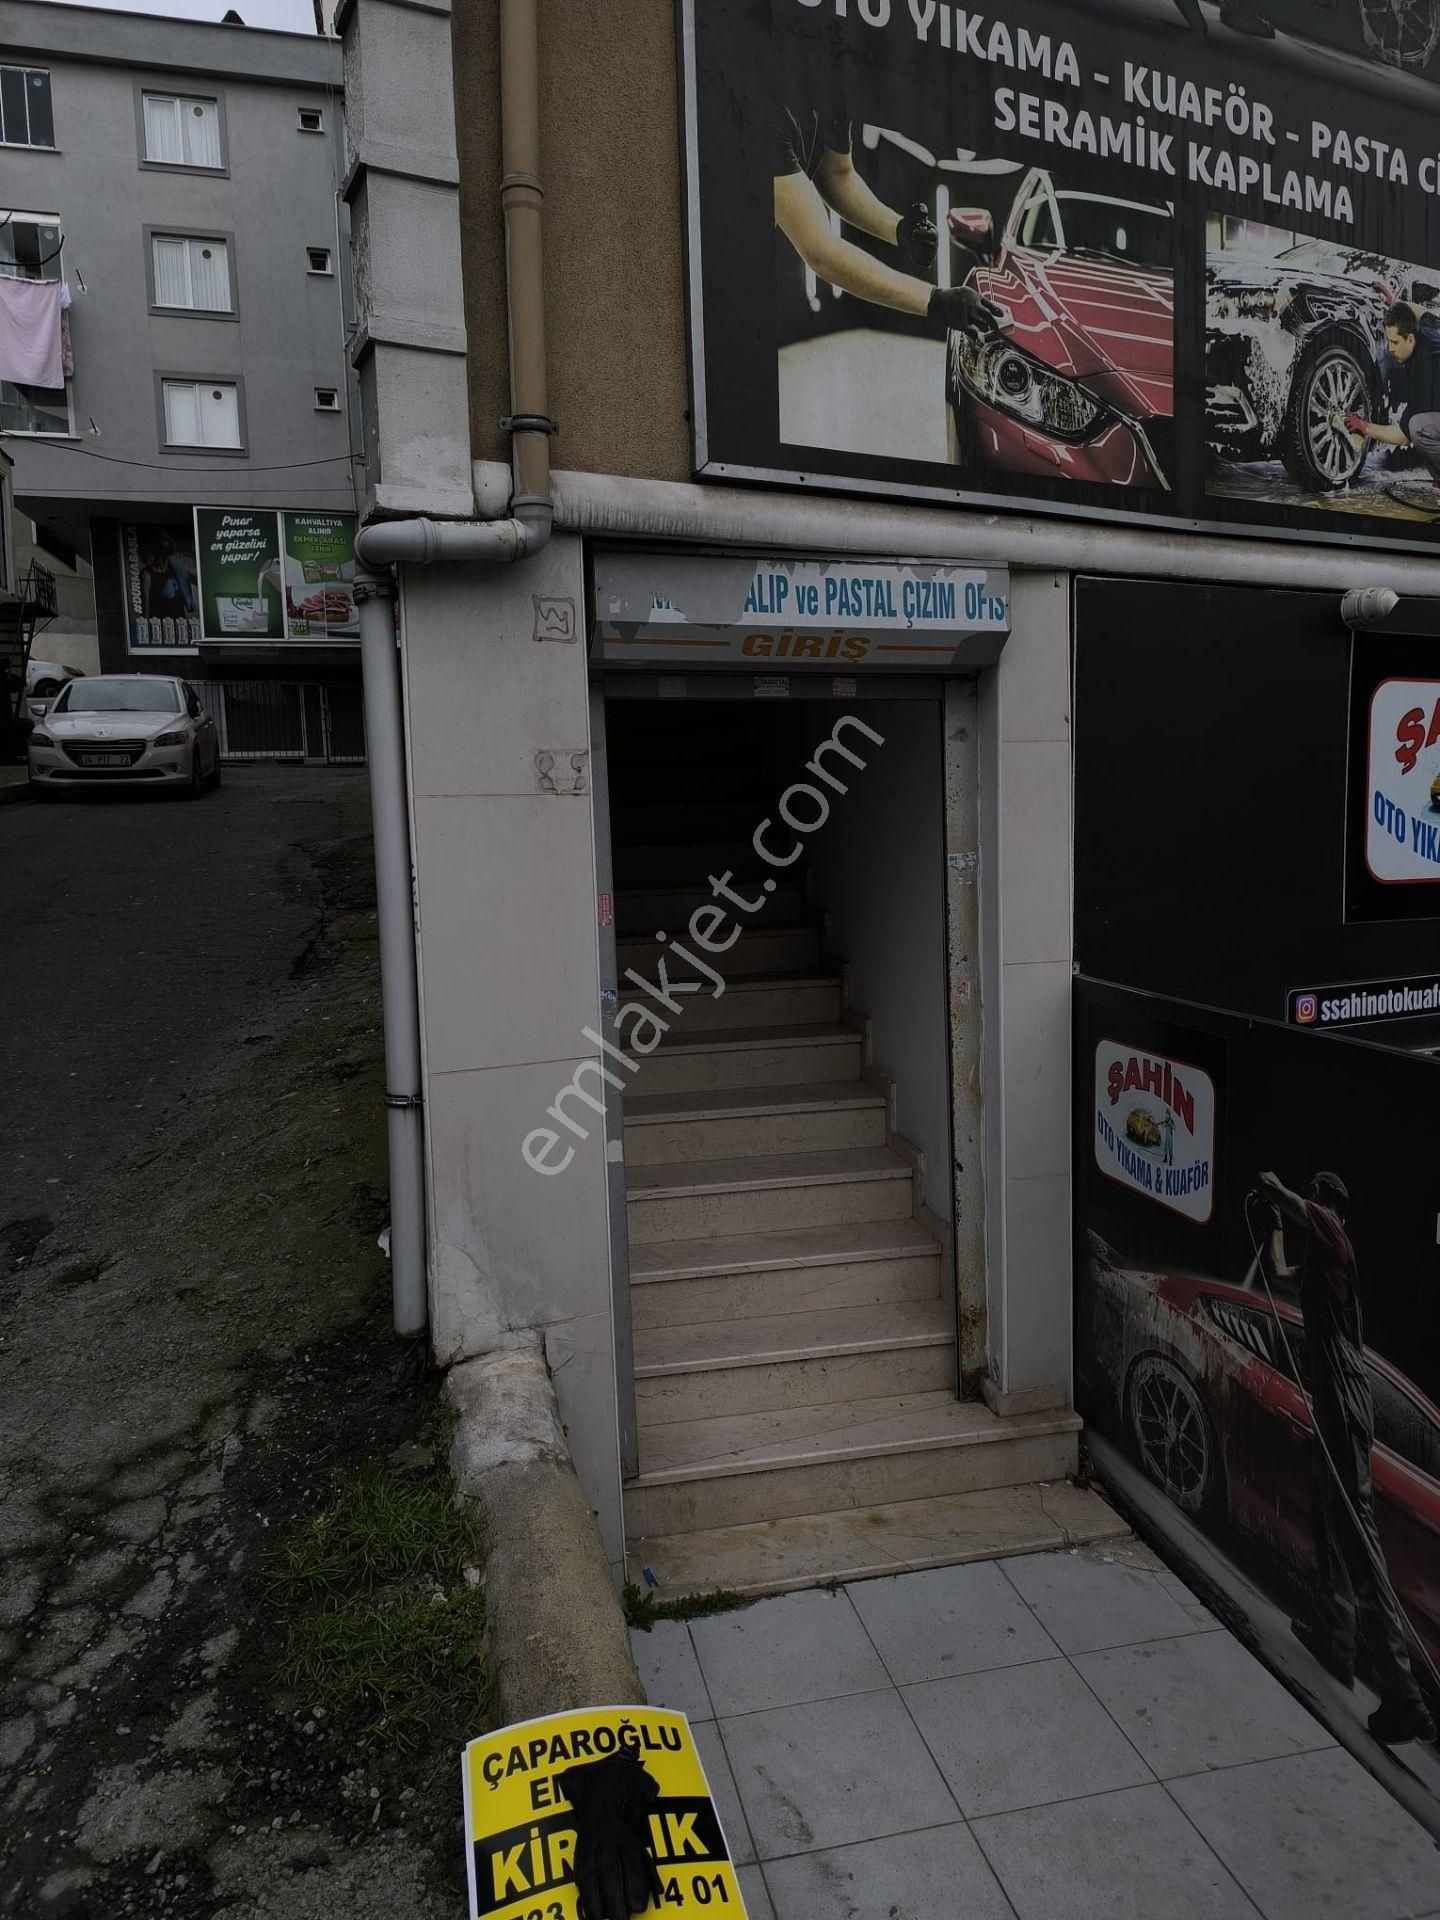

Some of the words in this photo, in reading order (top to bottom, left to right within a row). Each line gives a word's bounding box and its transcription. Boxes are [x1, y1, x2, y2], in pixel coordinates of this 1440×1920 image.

[907, 0, 1081, 87] YIKAMA
[1125, 61, 1276, 146] KUAFÖR
[1311, 120, 1409, 186] PASTA
[994, 87, 1175, 176] SERAMİK
[1188, 146, 1354, 225] KAPLAMA
[216, 528, 261, 540] yaparsa
[221, 515, 253, 527] Pınar
[295, 518, 343, 528] KAHVALTIYA
[308, 527, 332, 536] ALINIR
[210, 541, 223, 551] en
[224, 538, 268, 552] güzelini
[220, 551, 260, 565] yapar!
[795, 585, 818, 616] ve
[825, 577, 897, 618] PASTAL
[740, 628, 871, 664] GİRİŞ
[1374, 790, 1406, 844] OTO
[1321, 983, 1440, 1021] ssahinotokuaf
[1108, 1057, 1194, 1136] ŞAHİN
[1098, 1111, 1114, 1152] OTO
[1116, 1136, 1152, 1190] YIKAMA
[1165, 1159, 1209, 1196] KUAFÖR
[482, 1719, 683, 1791] ÇAPAROĞLU
[492, 1812, 710, 1902] KİRIK
[692, 1874, 729, 1905] 01
